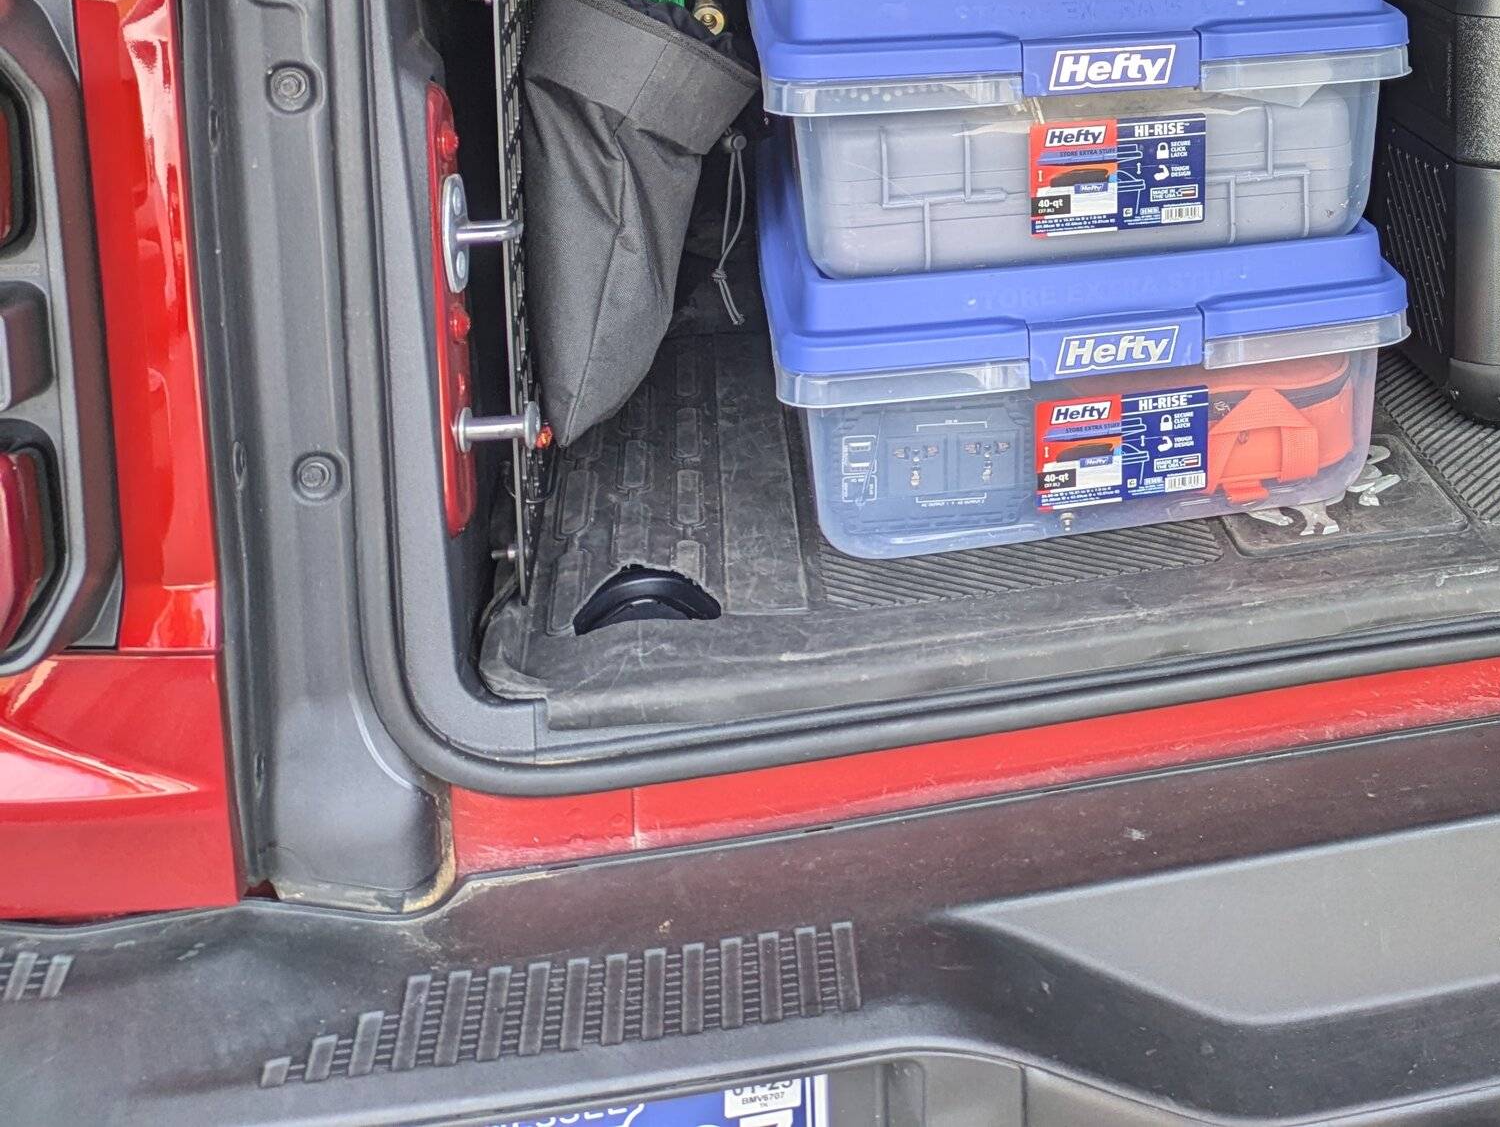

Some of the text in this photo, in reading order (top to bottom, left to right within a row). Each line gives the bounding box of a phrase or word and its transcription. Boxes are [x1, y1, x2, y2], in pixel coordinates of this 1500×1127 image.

[1059, 52, 1166, 85] Hefty
[1049, 128, 1103, 146] Hefty
[1037, 198, 1063, 210] 40-qt
[1065, 335, 1170, 367] Hefty
[1055, 404, 1107, 421] Hefty
[1043, 472, 1069, 484] 40-qt
